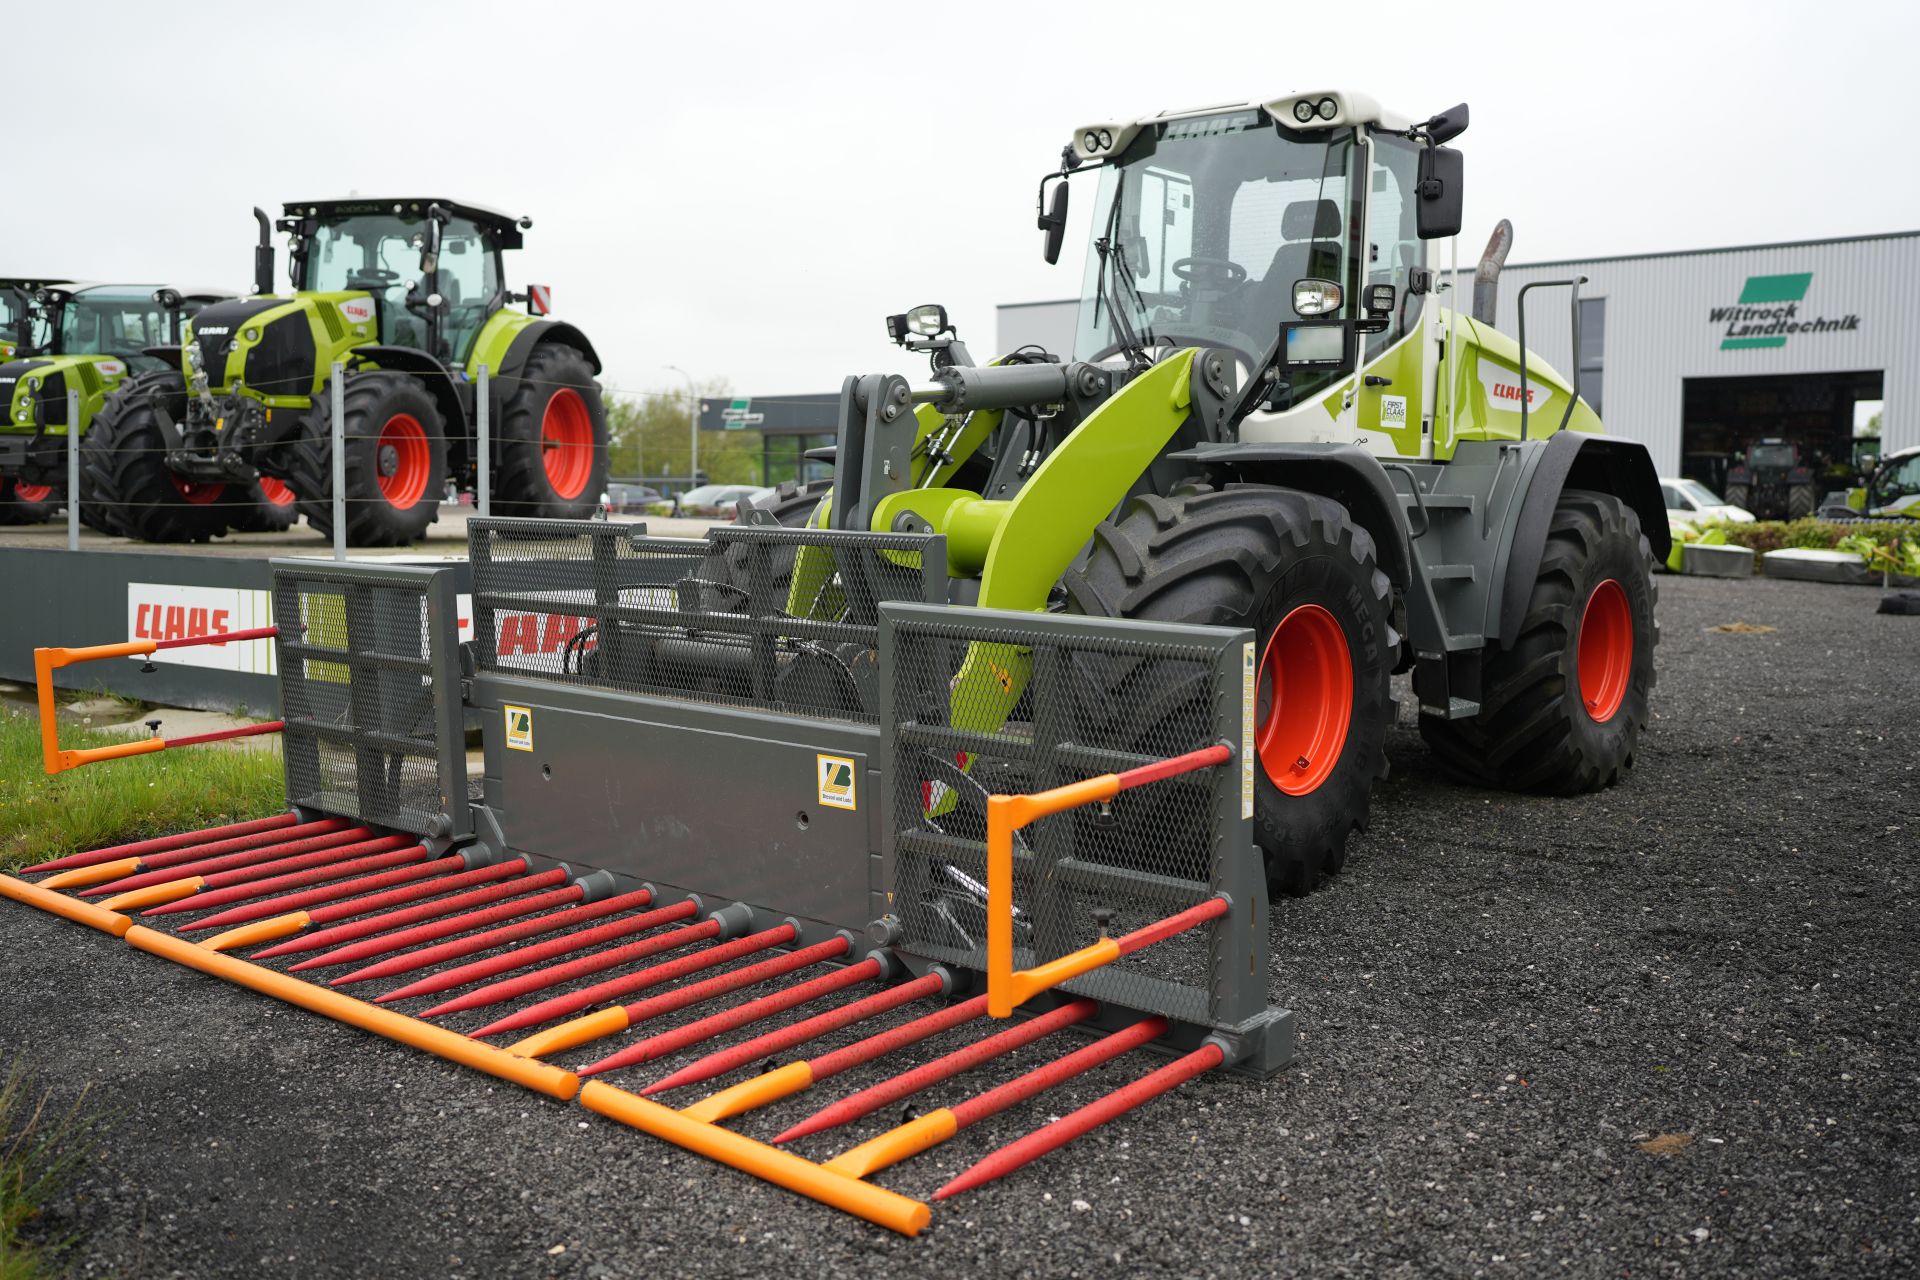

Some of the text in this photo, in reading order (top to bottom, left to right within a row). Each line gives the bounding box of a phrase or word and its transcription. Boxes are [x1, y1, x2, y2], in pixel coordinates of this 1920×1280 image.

[1709, 303, 1798, 323] Wittrock
[1726, 314, 1861, 337] Landtechnik
[1493, 383, 1534, 403] CLAAS
[1386, 408, 1405, 416] CLAAS
[1387, 401, 1403, 409] FIRST
[136, 603, 229, 646] CLAAS
